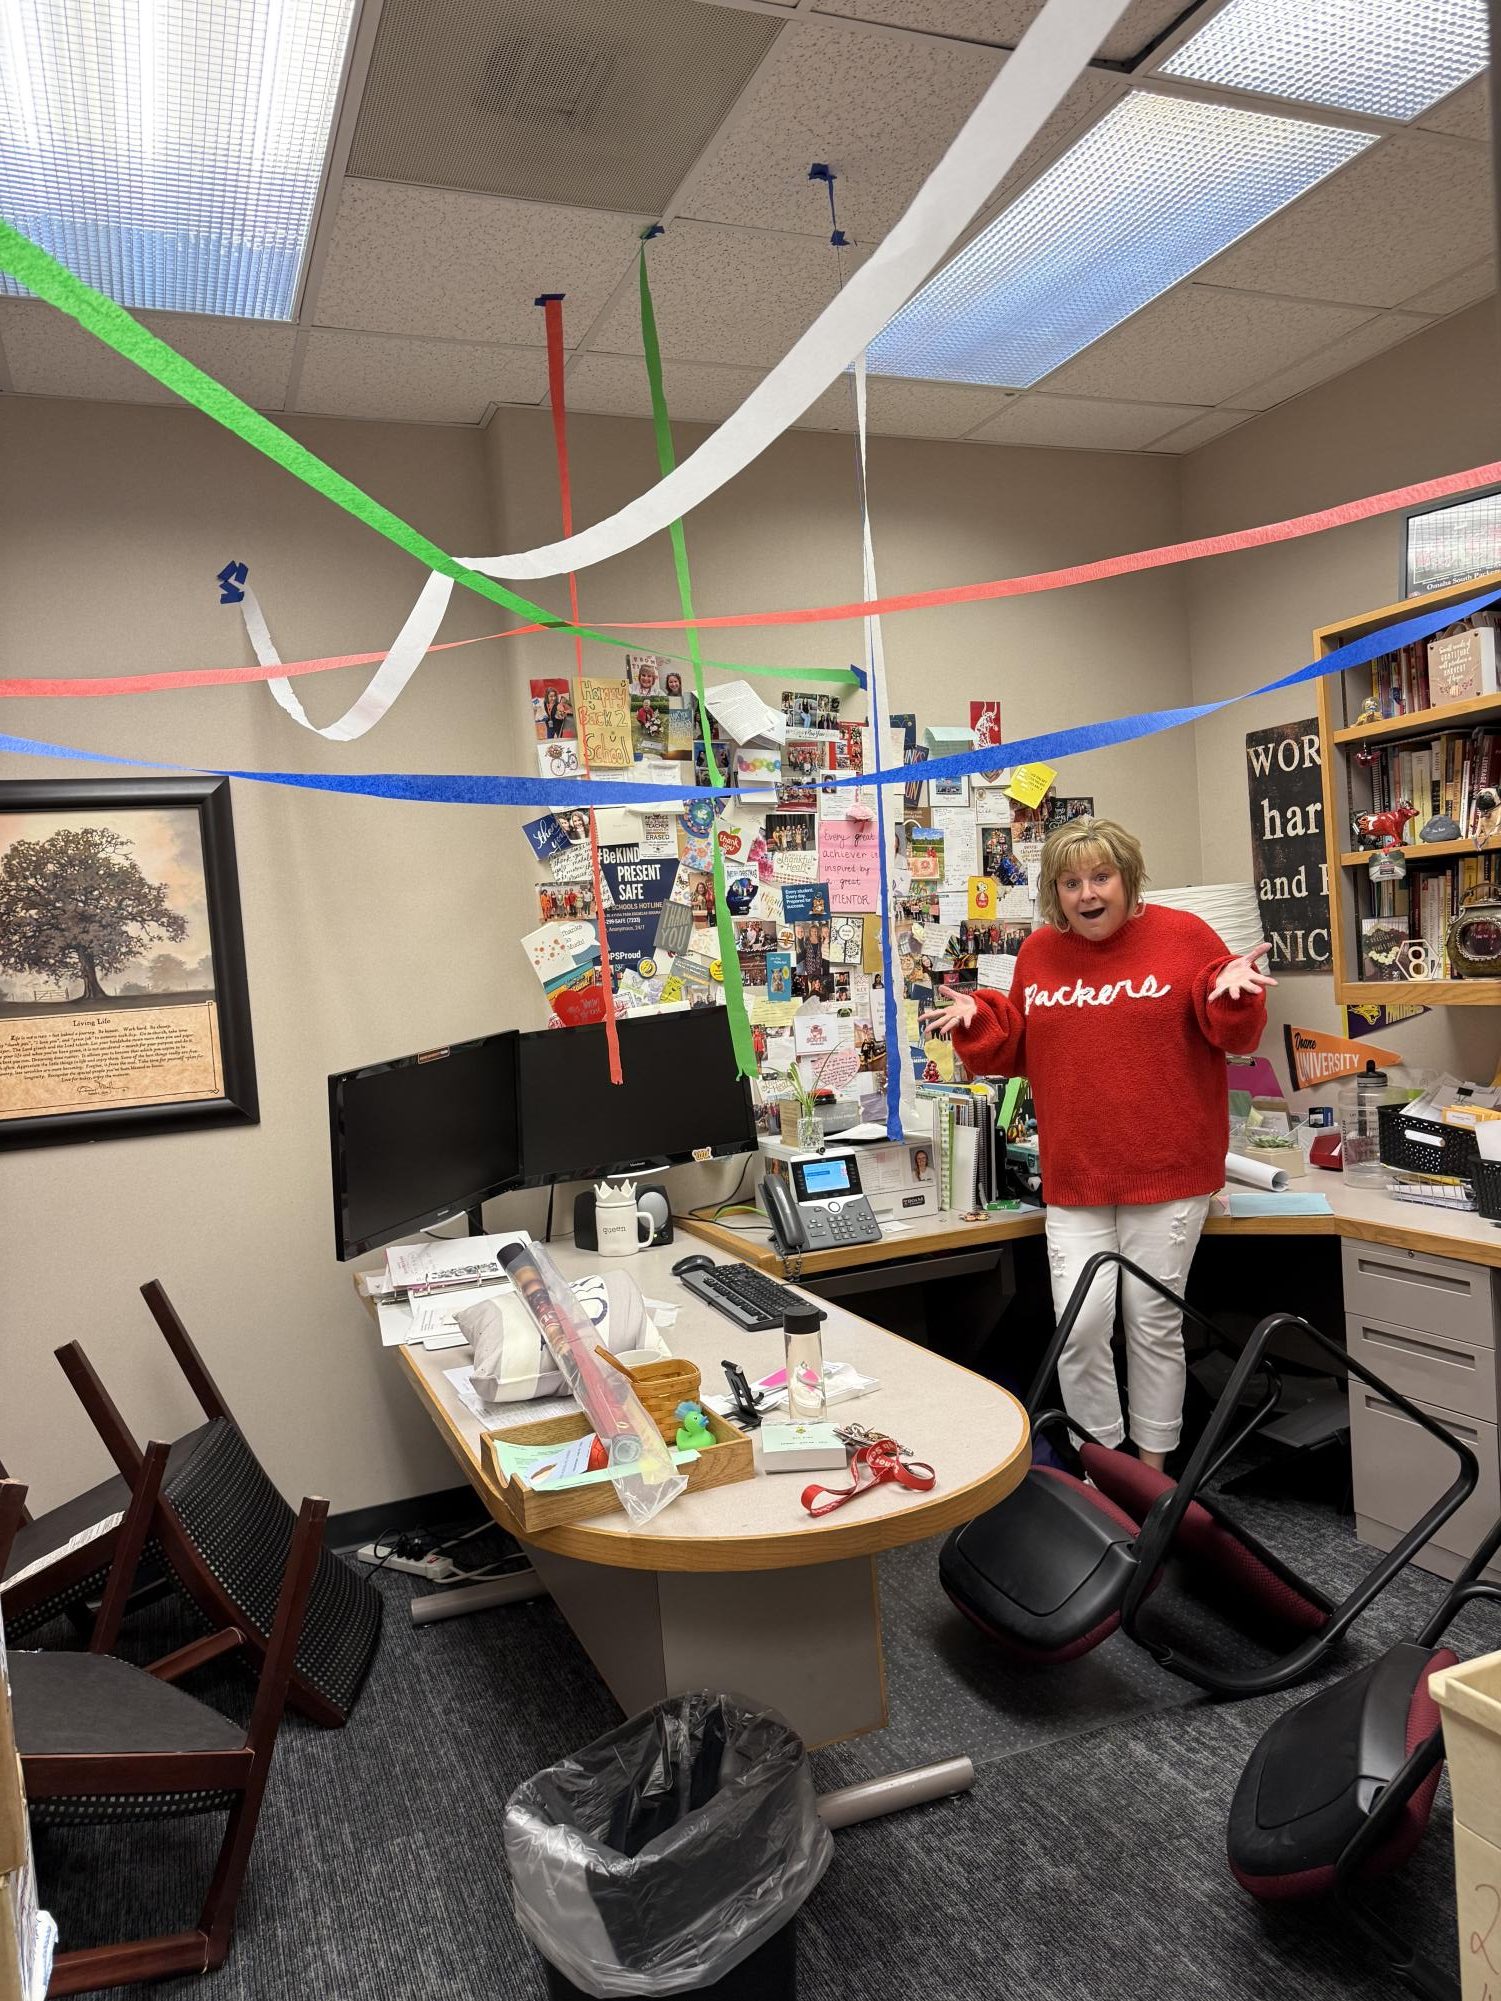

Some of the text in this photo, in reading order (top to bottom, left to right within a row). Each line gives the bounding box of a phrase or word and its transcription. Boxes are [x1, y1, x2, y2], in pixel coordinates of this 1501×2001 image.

[1426, 580, 1451, 590] Omaha
[581, 680, 626, 710] Happy
[578, 706, 628, 728] Back 2
[585, 733, 630, 764] School
[719, 834, 739, 848] thank
[722, 842, 735, 851] you
[824, 831, 875, 848] Every great
[822, 850, 866, 858] achiever
[617, 864, 661, 882] PRESENT
[824, 864, 870, 876] inspired by
[840, 878, 860, 890] great
[1260, 866, 1308, 900] and
[619, 884, 644, 900] SAFE
[832, 894, 871, 906] MENTOR
[663, 904, 692, 928] THANK
[561, 924, 583, 936] Thanks
[660, 926, 688, 950] YOU
[1272, 930, 1334, 962] NIC
[609, 950, 641, 961] PSProud
[1294, 1032, 1317, 1050] Doane
[1296, 1052, 1360, 1082] UNIVERSITY
[602, 1225, 627, 1235] queen
